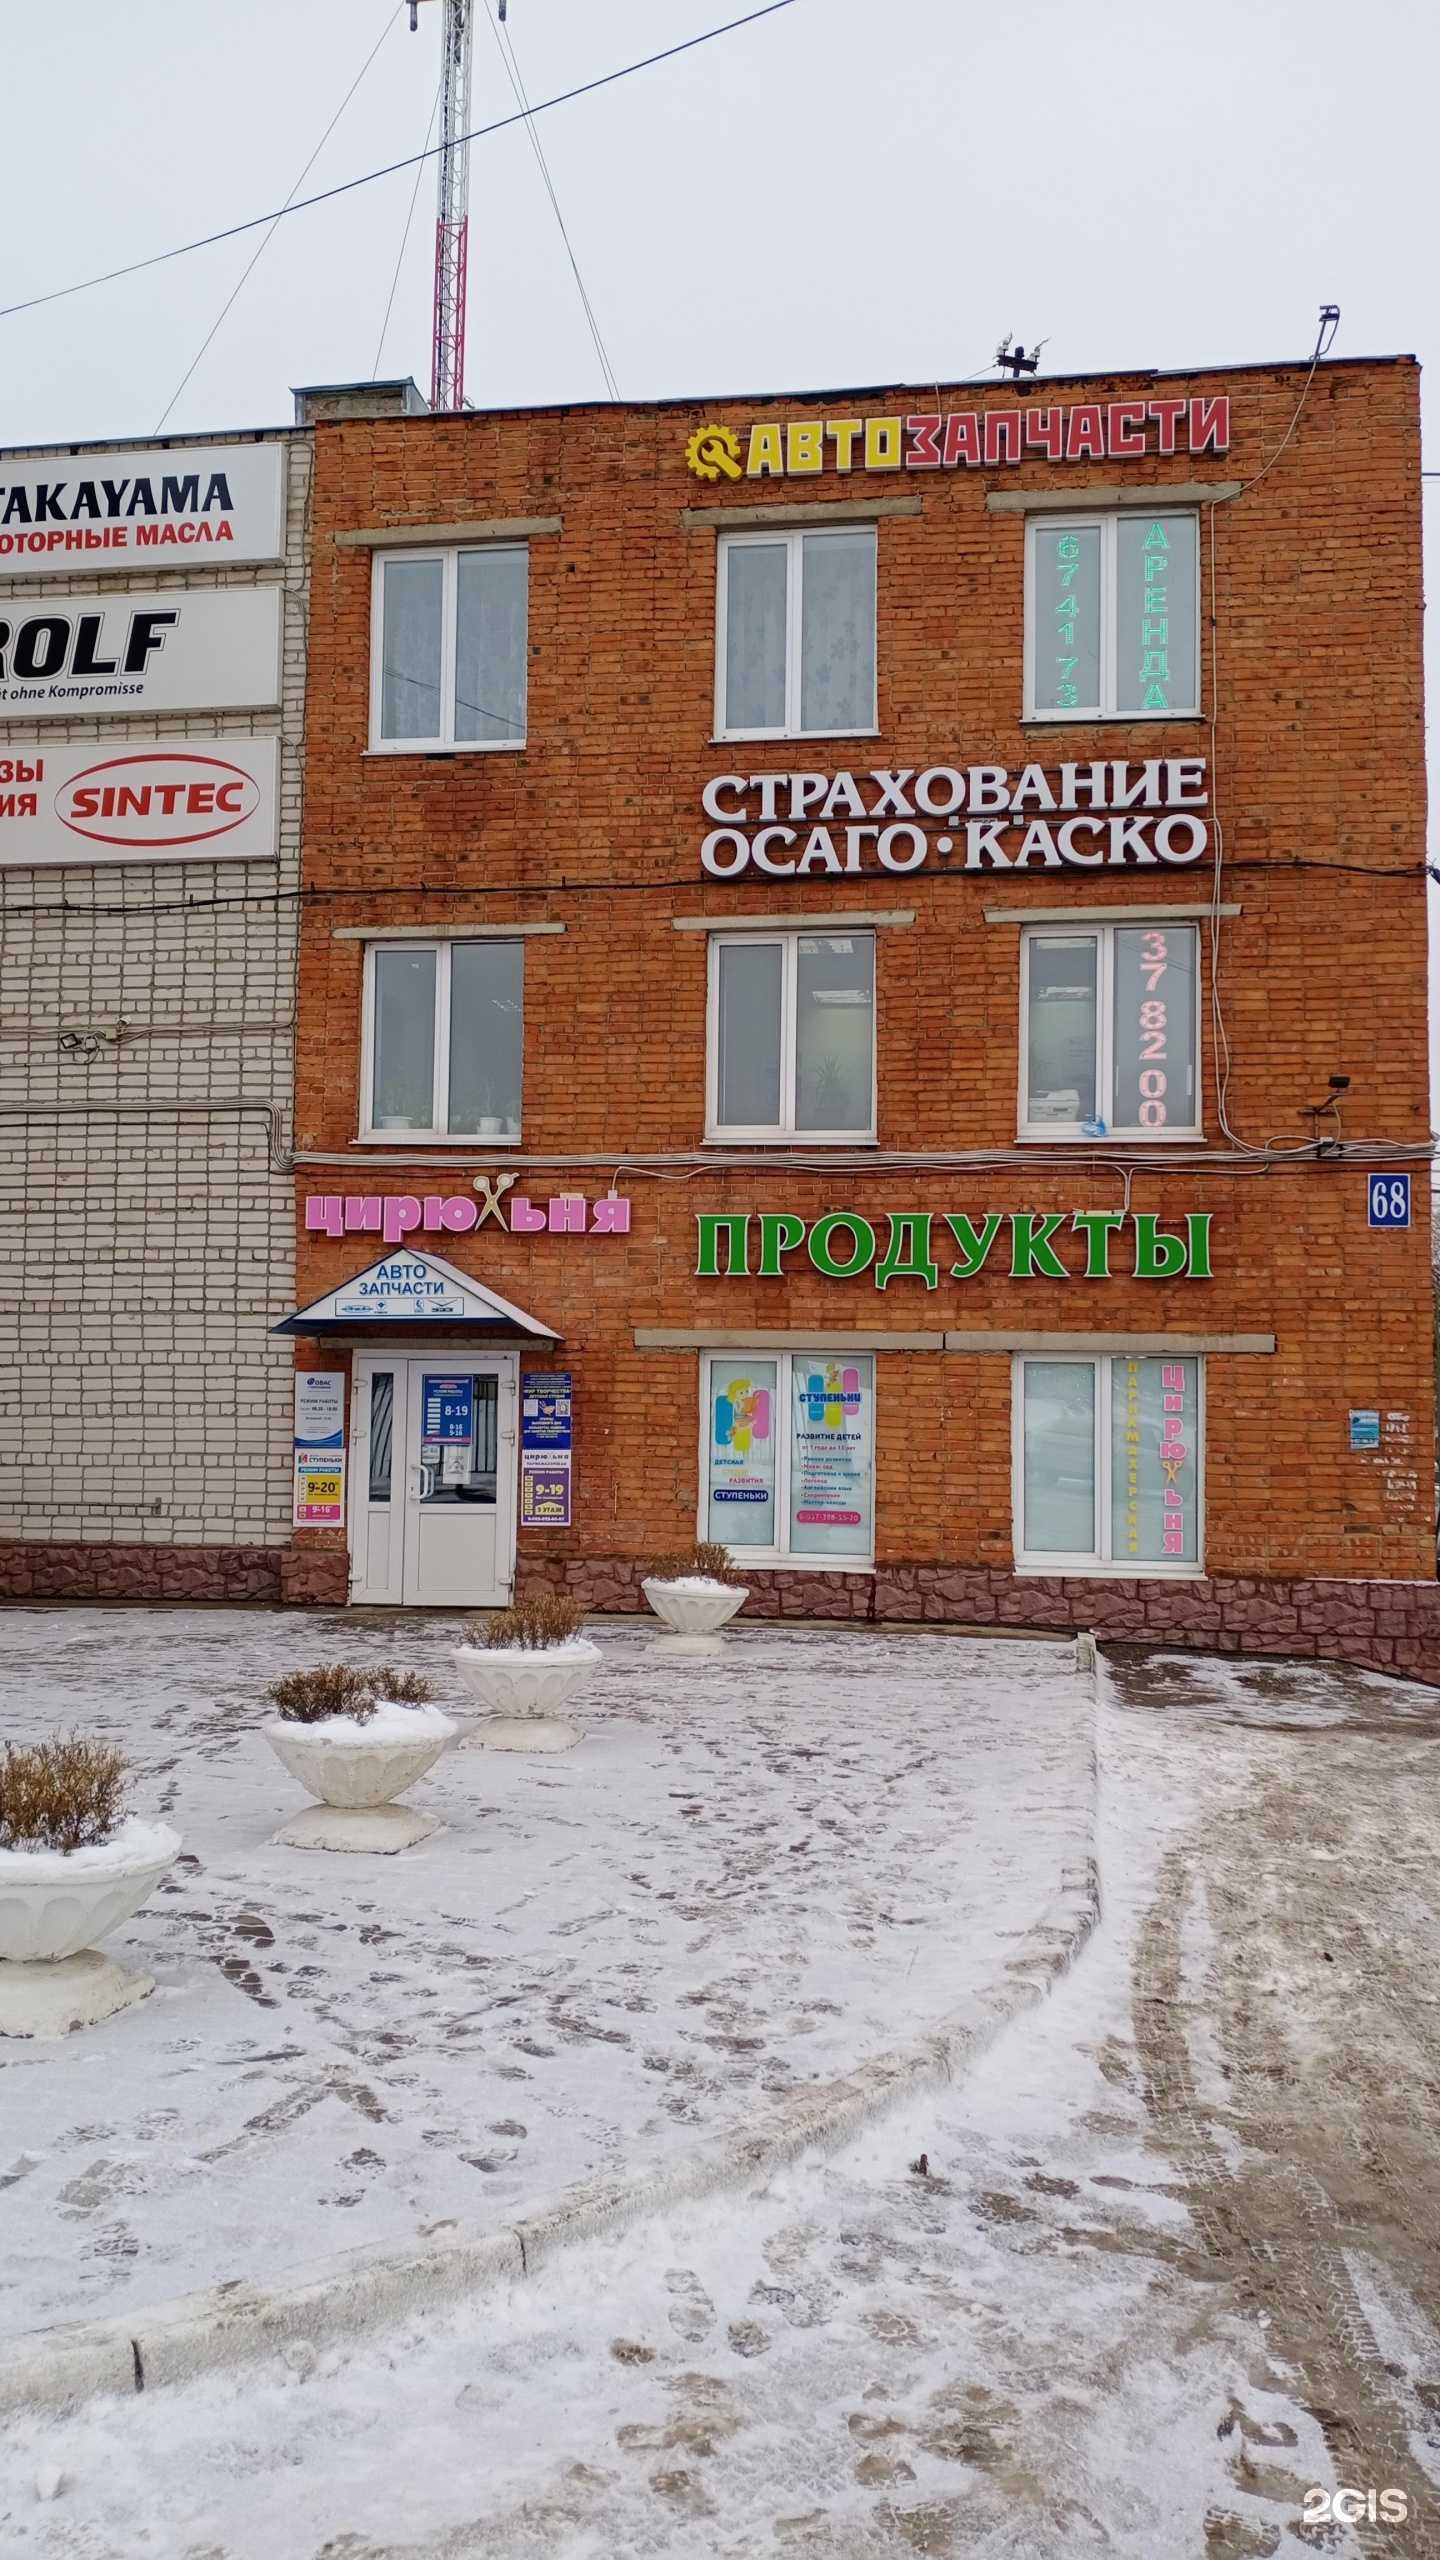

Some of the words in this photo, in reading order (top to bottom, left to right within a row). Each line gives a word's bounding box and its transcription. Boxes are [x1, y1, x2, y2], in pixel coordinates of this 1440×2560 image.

[746, 396, 1230, 478] АВТОЗАПЧАСТИ
[0, 473, 234, 524] AKAYAMA
[136, 520, 234, 546] МАСЛА
[1139, 523, 1169, 709] АРЕНДА
[10, 686, 45, 700] ohne
[49, 682, 144, 700] Kompromisse
[70, 782, 244, 818] SINTEC
[702, 758, 1208, 823] СТРАХОВАНИЕ
[1372, 1181, 1406, 1219] 68
[694, 1212, 1214, 1290] ПРОДУКТЫ
[359, 1282, 445, 1296] ЗАПЧАСТИ
[376, 1264, 427, 1280] АВТО
[715, 1492, 767, 1500] СТУПЕНЬКИ
